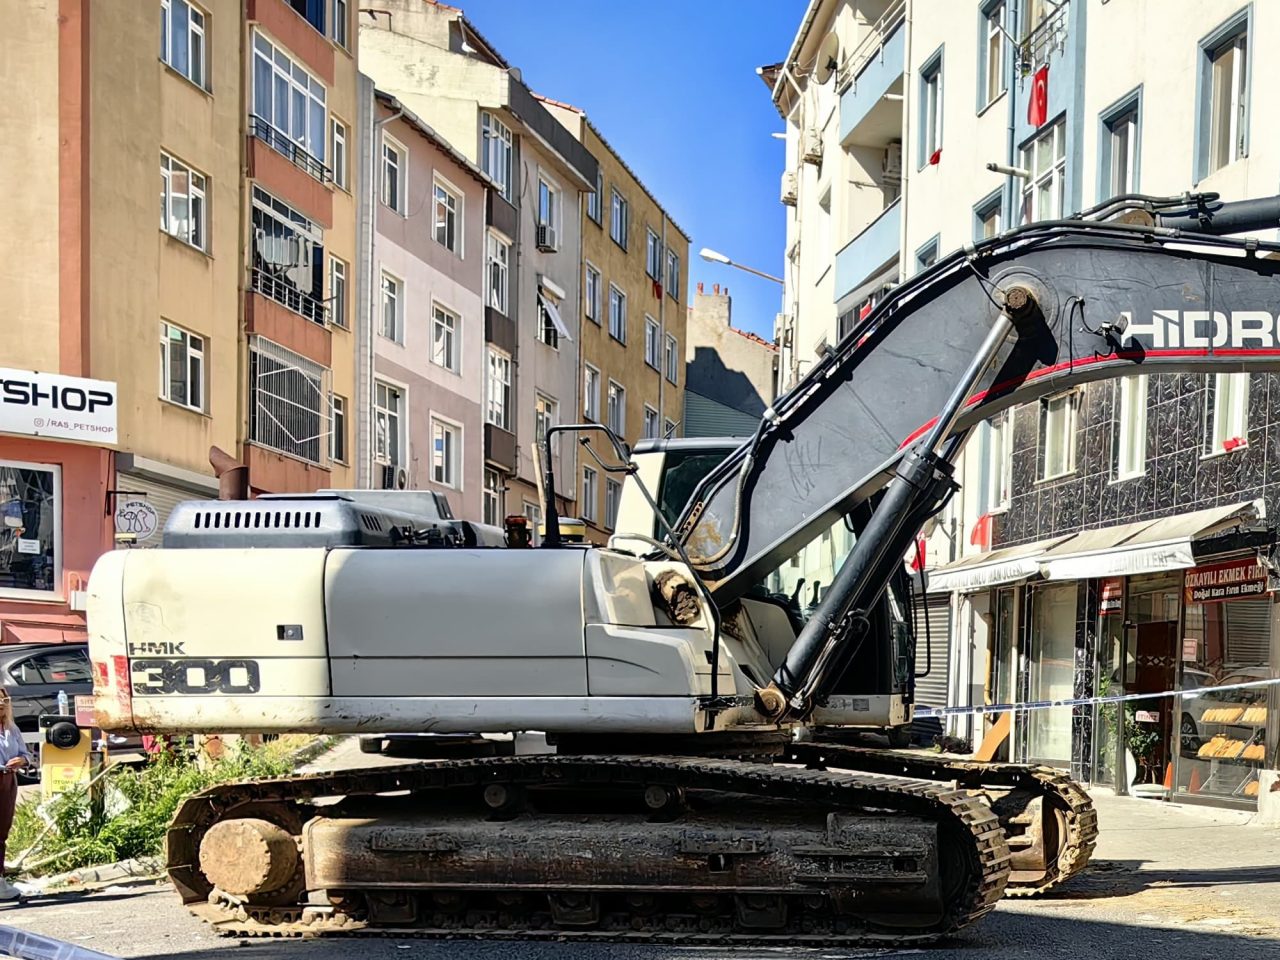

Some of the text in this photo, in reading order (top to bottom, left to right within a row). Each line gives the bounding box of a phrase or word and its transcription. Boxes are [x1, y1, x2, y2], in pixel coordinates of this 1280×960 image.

[1219, 566, 1246, 584] EKMEK
[1193, 588, 1211, 600] Doğal
[129, 642, 186, 655] HMK
[132, 660, 261, 695] 300
